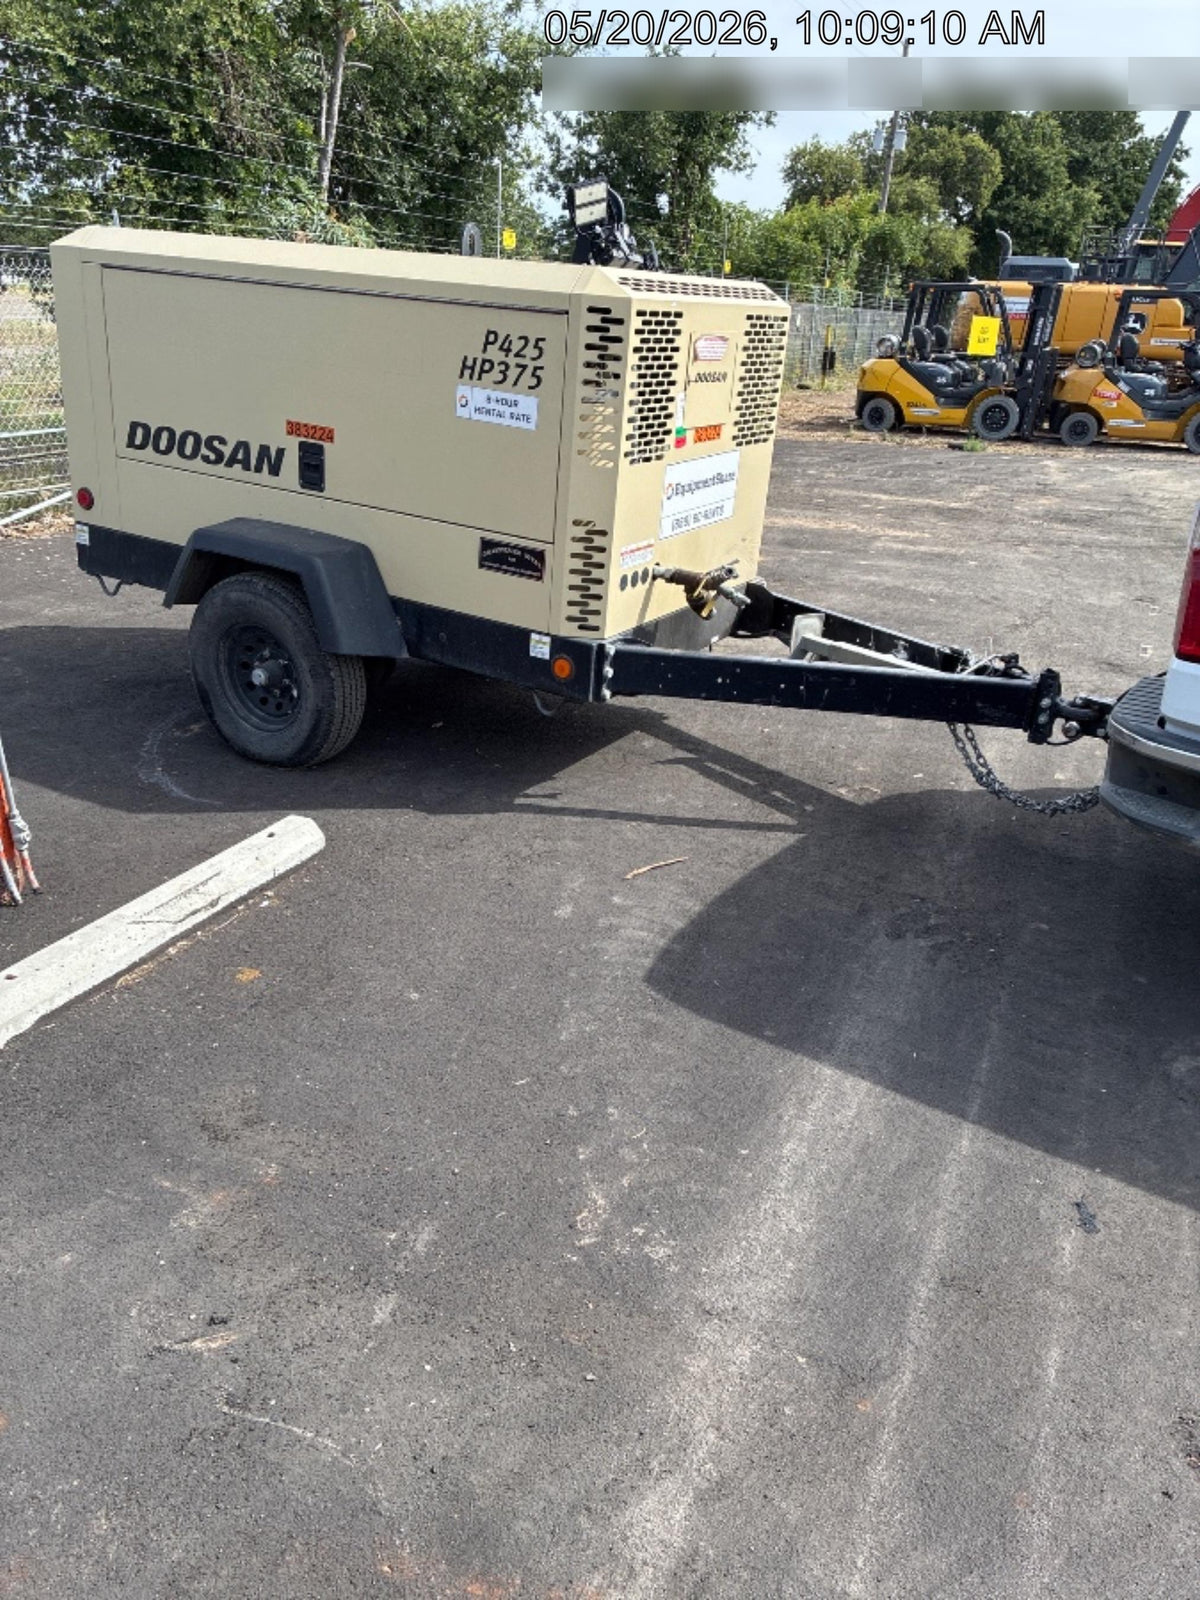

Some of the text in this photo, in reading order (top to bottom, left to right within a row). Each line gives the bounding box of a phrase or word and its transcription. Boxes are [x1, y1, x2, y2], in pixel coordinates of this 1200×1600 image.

[482, 328, 546, 361] P425
[458, 355, 545, 390] HP375
[286, 420, 335, 444] 383224
[509, 411, 532, 424] RATE
[126, 420, 287, 477] DOOSAN
